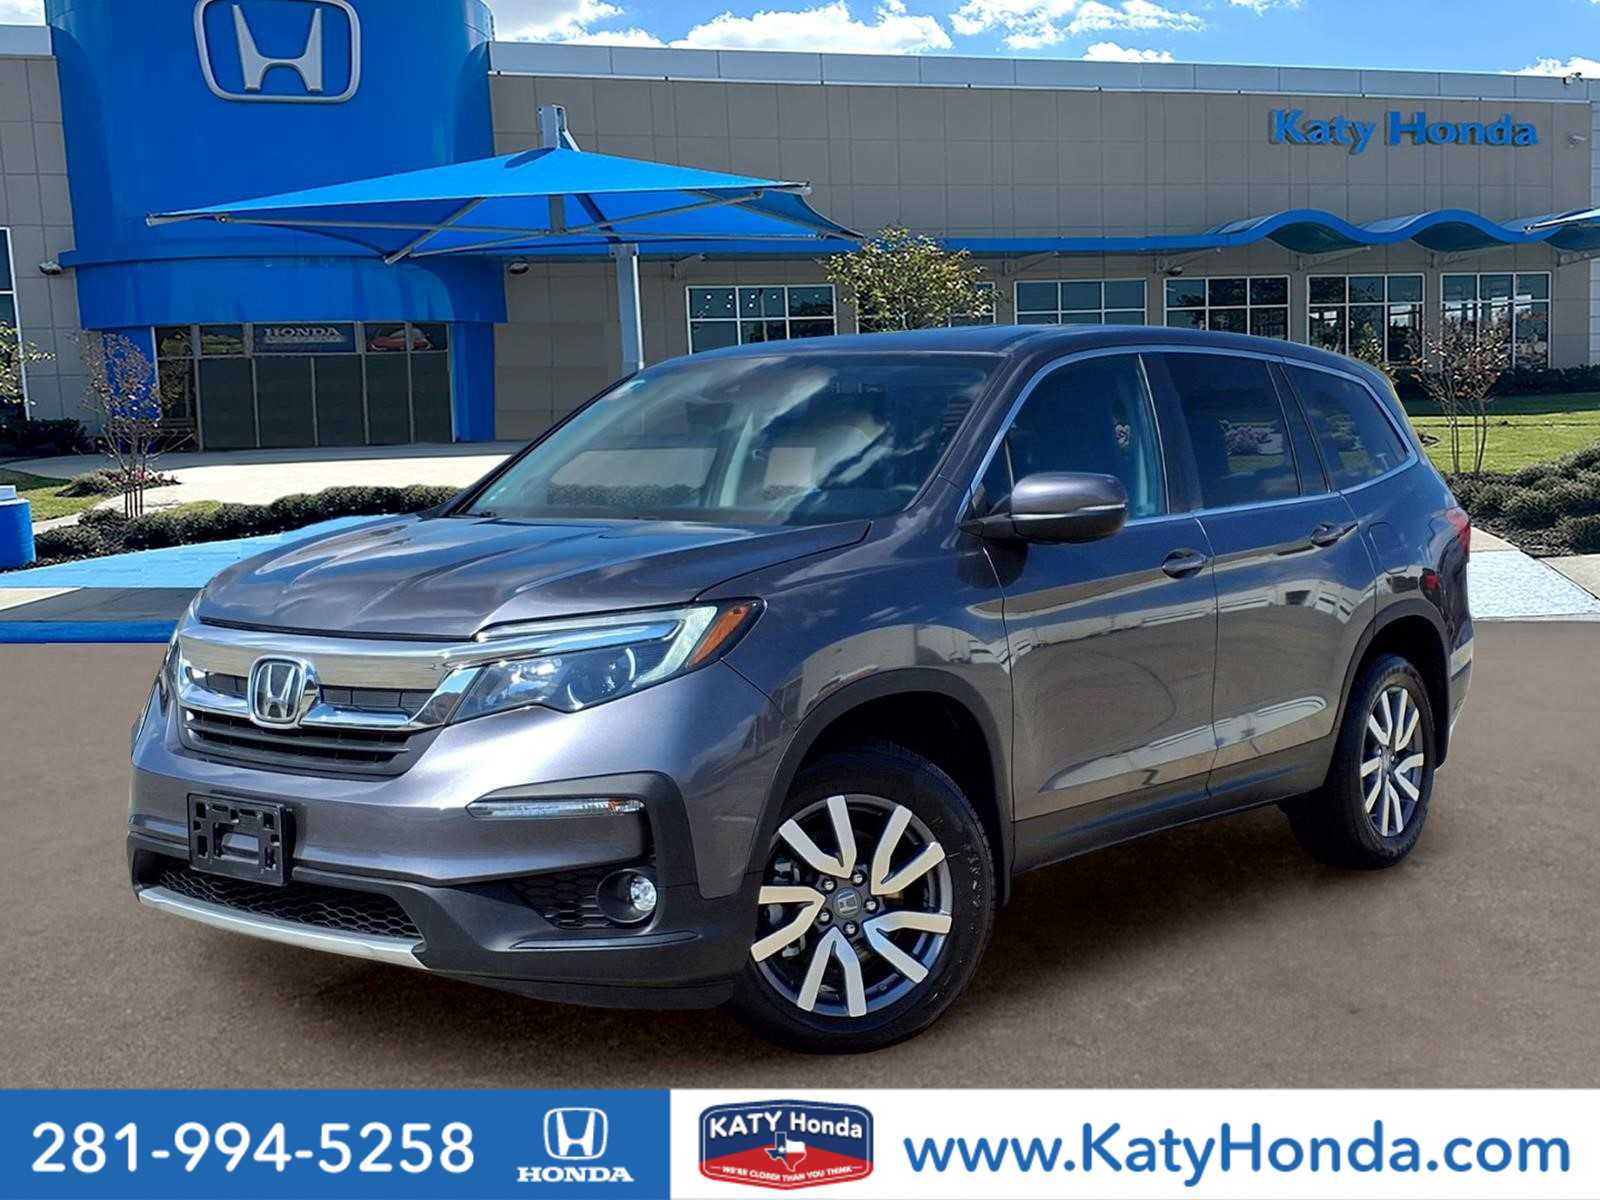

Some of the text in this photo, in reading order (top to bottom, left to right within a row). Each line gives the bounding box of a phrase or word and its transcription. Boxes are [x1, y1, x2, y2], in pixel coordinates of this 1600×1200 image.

[1270, 109, 1539, 154] Katy Honda
[264, 327, 342, 337] HONDA
